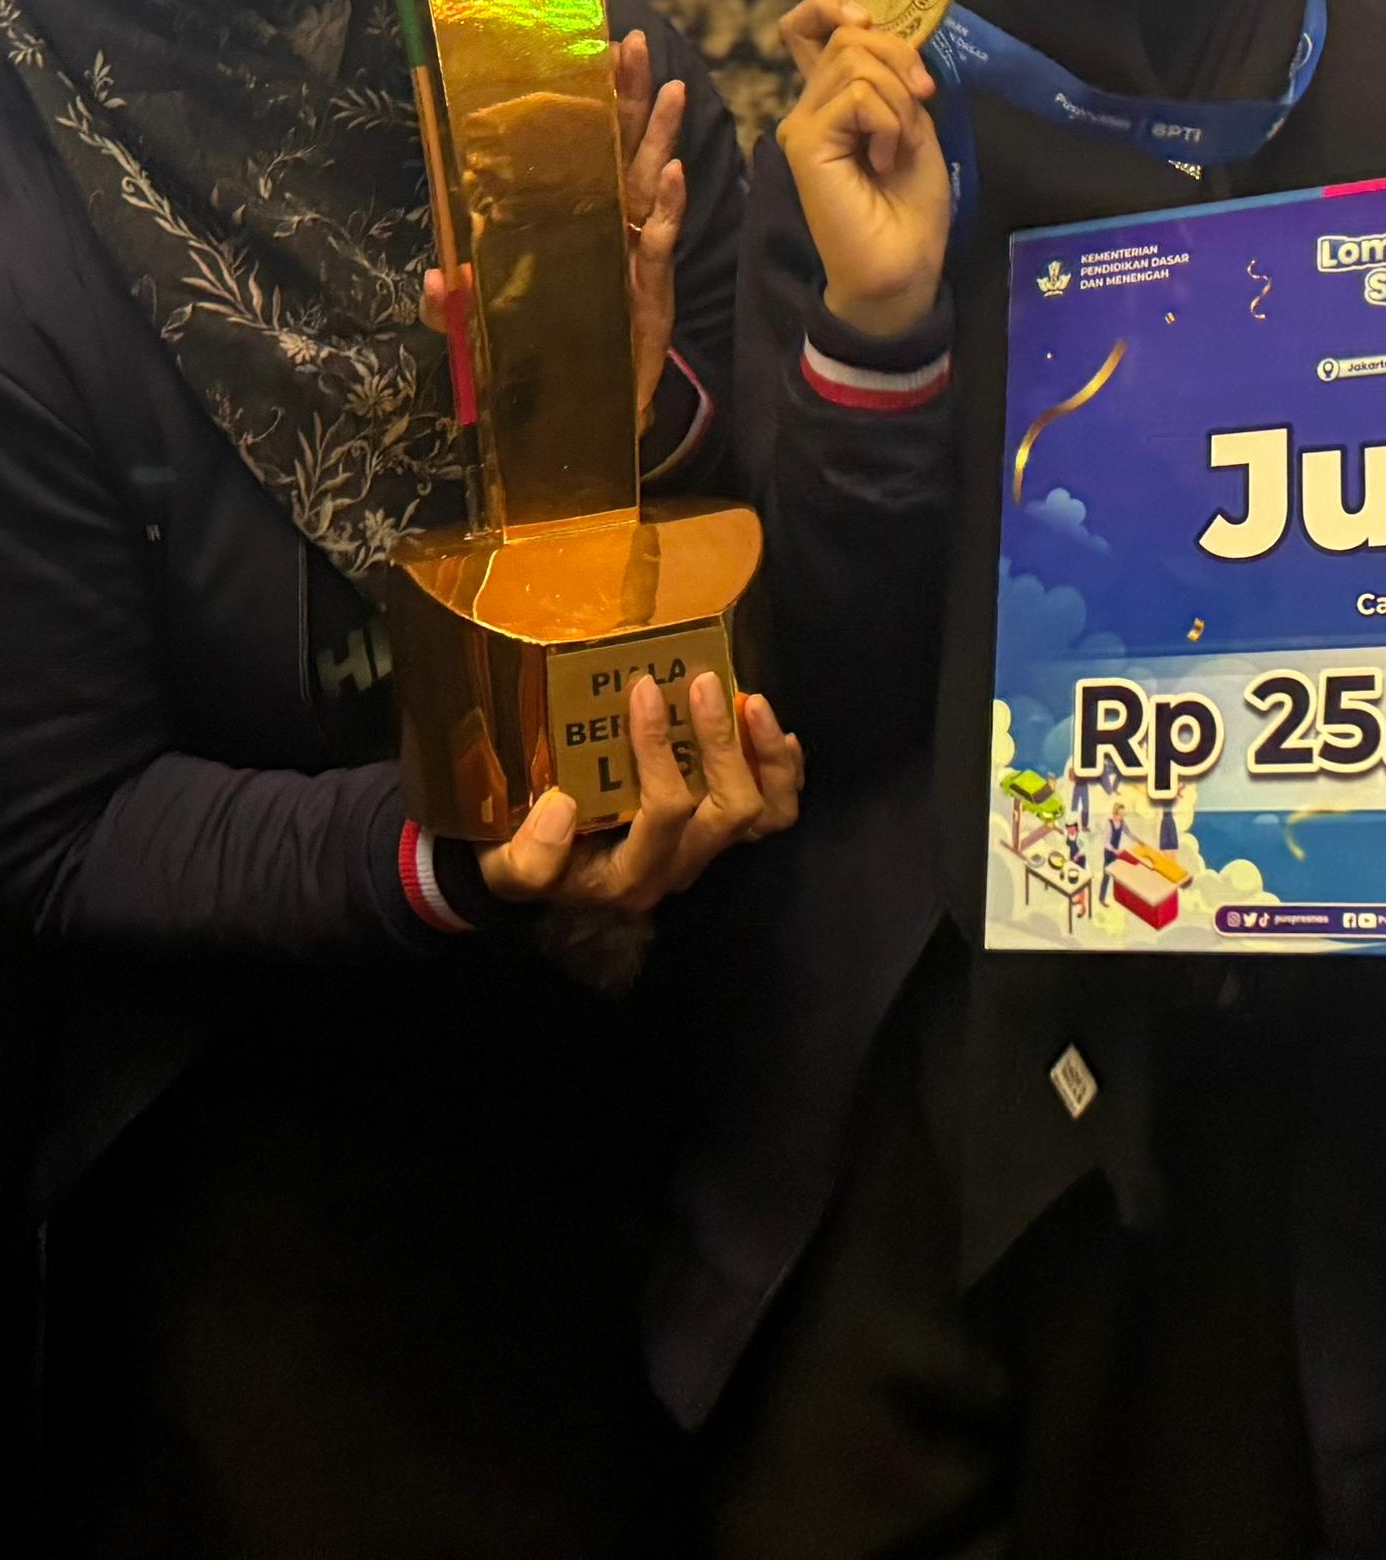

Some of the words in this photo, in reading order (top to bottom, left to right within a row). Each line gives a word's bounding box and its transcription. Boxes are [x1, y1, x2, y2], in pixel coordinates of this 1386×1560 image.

[1080, 244, 1158, 264] KEMENTERIAN
[1080, 259, 1149, 277] PENDIDIKAN
[1151, 253, 1190, 267] DASAR
[1080, 279, 1104, 290] DAN
[1105, 269, 1169, 286] MENENGAH
[591, 658, 686, 697] PILA
[1075, 683, 1217, 793] Rp
